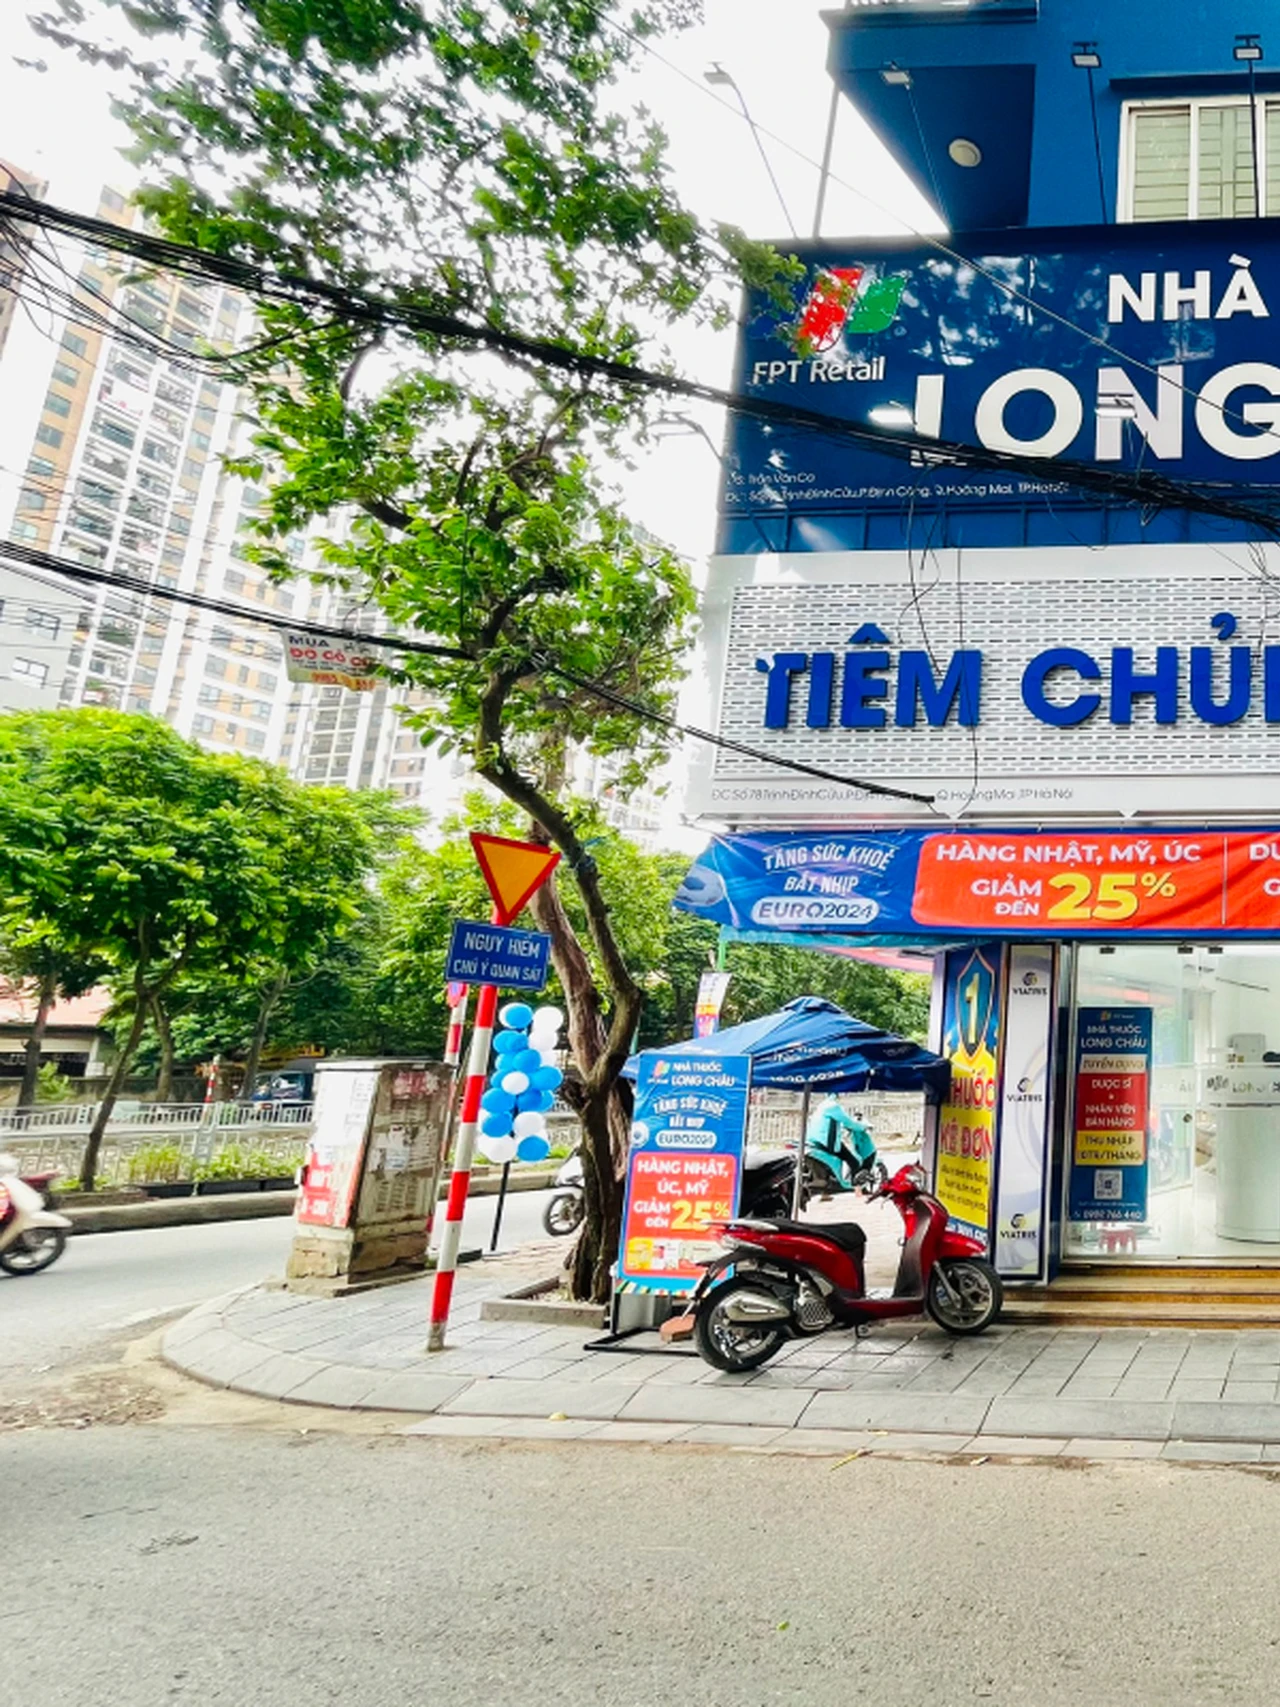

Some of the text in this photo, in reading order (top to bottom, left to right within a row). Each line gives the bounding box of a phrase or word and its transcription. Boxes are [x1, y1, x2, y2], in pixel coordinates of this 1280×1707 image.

[1108, 253, 1269, 323] NHÀ
[753, 355, 886, 385] FPT Retail
[288, 635, 330, 648] MUA
[755, 622, 983, 729] TIÊM
[812, 841, 846, 863] SỨC
[936, 838, 1201, 868] HÀNG NHẬT, MỸ, ÚC
[820, 876, 859, 897] NHỊP
[971, 872, 1177, 922] GIẢM 25%
[995, 897, 1040, 917] ĐẾN
[758, 902, 874, 920] EURO2024
[463, 931, 541, 959] NGUY HIỂM
[453, 956, 542, 982] CHÚ Ý QUAN SÁT
[1012, 986, 1048, 997] VIATRIS
[1080, 1034, 1147, 1049] LONG CHÂU
[671, 1074, 703, 1087] LONG
[704, 1072, 736, 1087] CHÂU
[951, 1068, 997, 1110] HUỐC
[1007, 1093, 1043, 1103] VIATRIS
[637, 1158, 729, 1179] HÀNG NHẬT,
[657, 1178, 710, 1197] ÚC, MỸ
[633, 1197, 671, 1214] GIẢM
[645, 1213, 669, 1228] ĐẾN
[1000, 1229, 1037, 1240] VIATRIS
